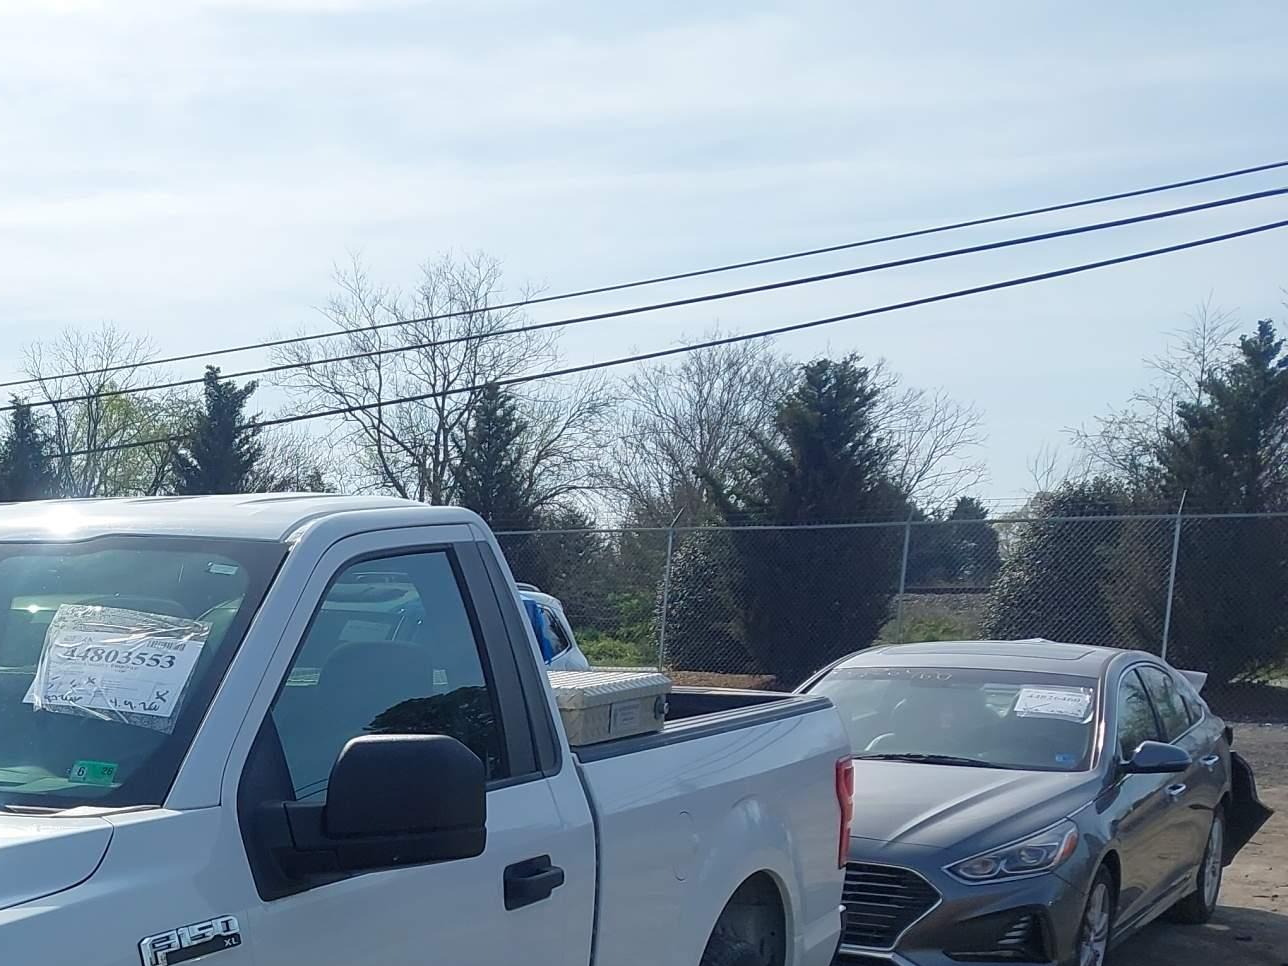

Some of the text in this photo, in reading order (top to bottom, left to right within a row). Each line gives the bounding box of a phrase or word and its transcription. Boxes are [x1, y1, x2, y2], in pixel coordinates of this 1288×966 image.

[63, 647, 176, 669] 44803553
[77, 766, 86, 777] 6
[224, 937, 239, 947] XL
